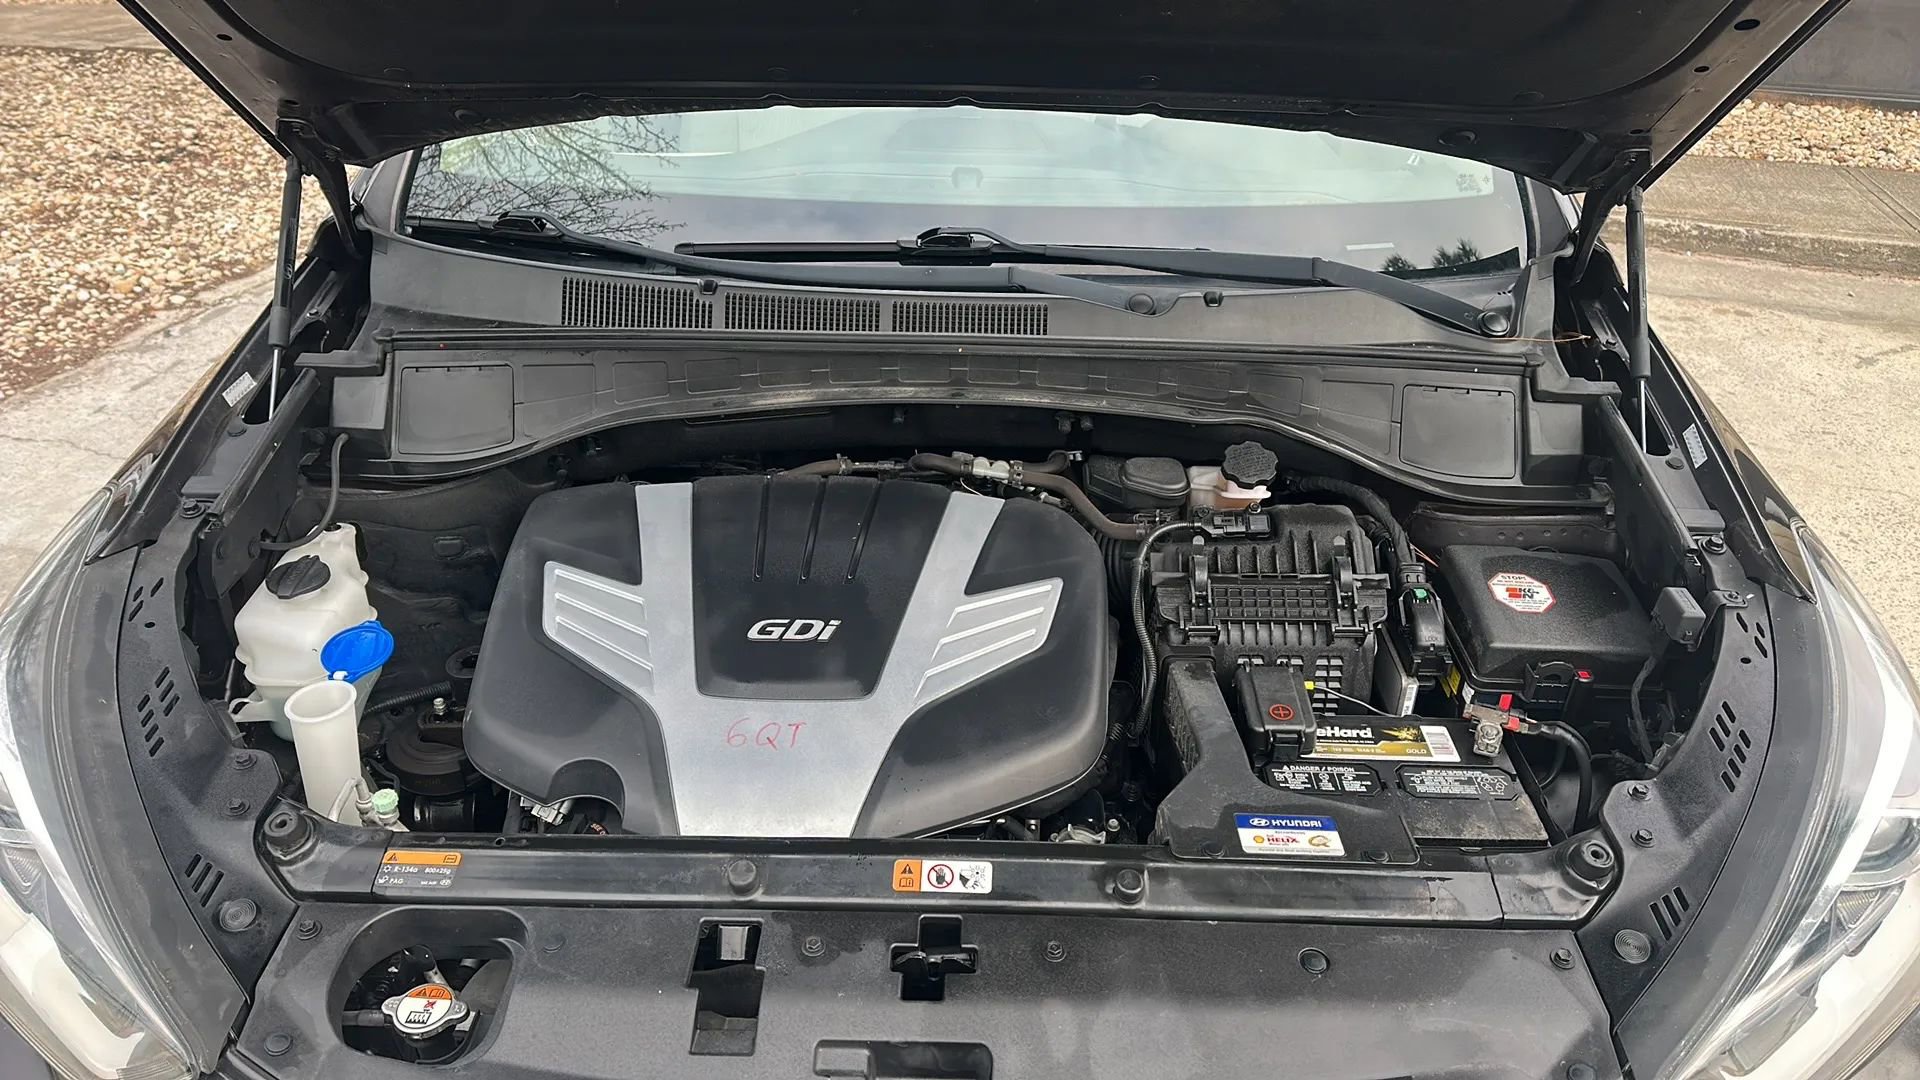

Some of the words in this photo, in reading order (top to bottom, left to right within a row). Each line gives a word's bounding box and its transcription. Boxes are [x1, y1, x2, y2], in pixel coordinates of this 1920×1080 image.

[746, 619, 842, 643] GDi
[1316, 726, 1373, 738] eHard
[1271, 819, 1322, 828] HYUNDAI
